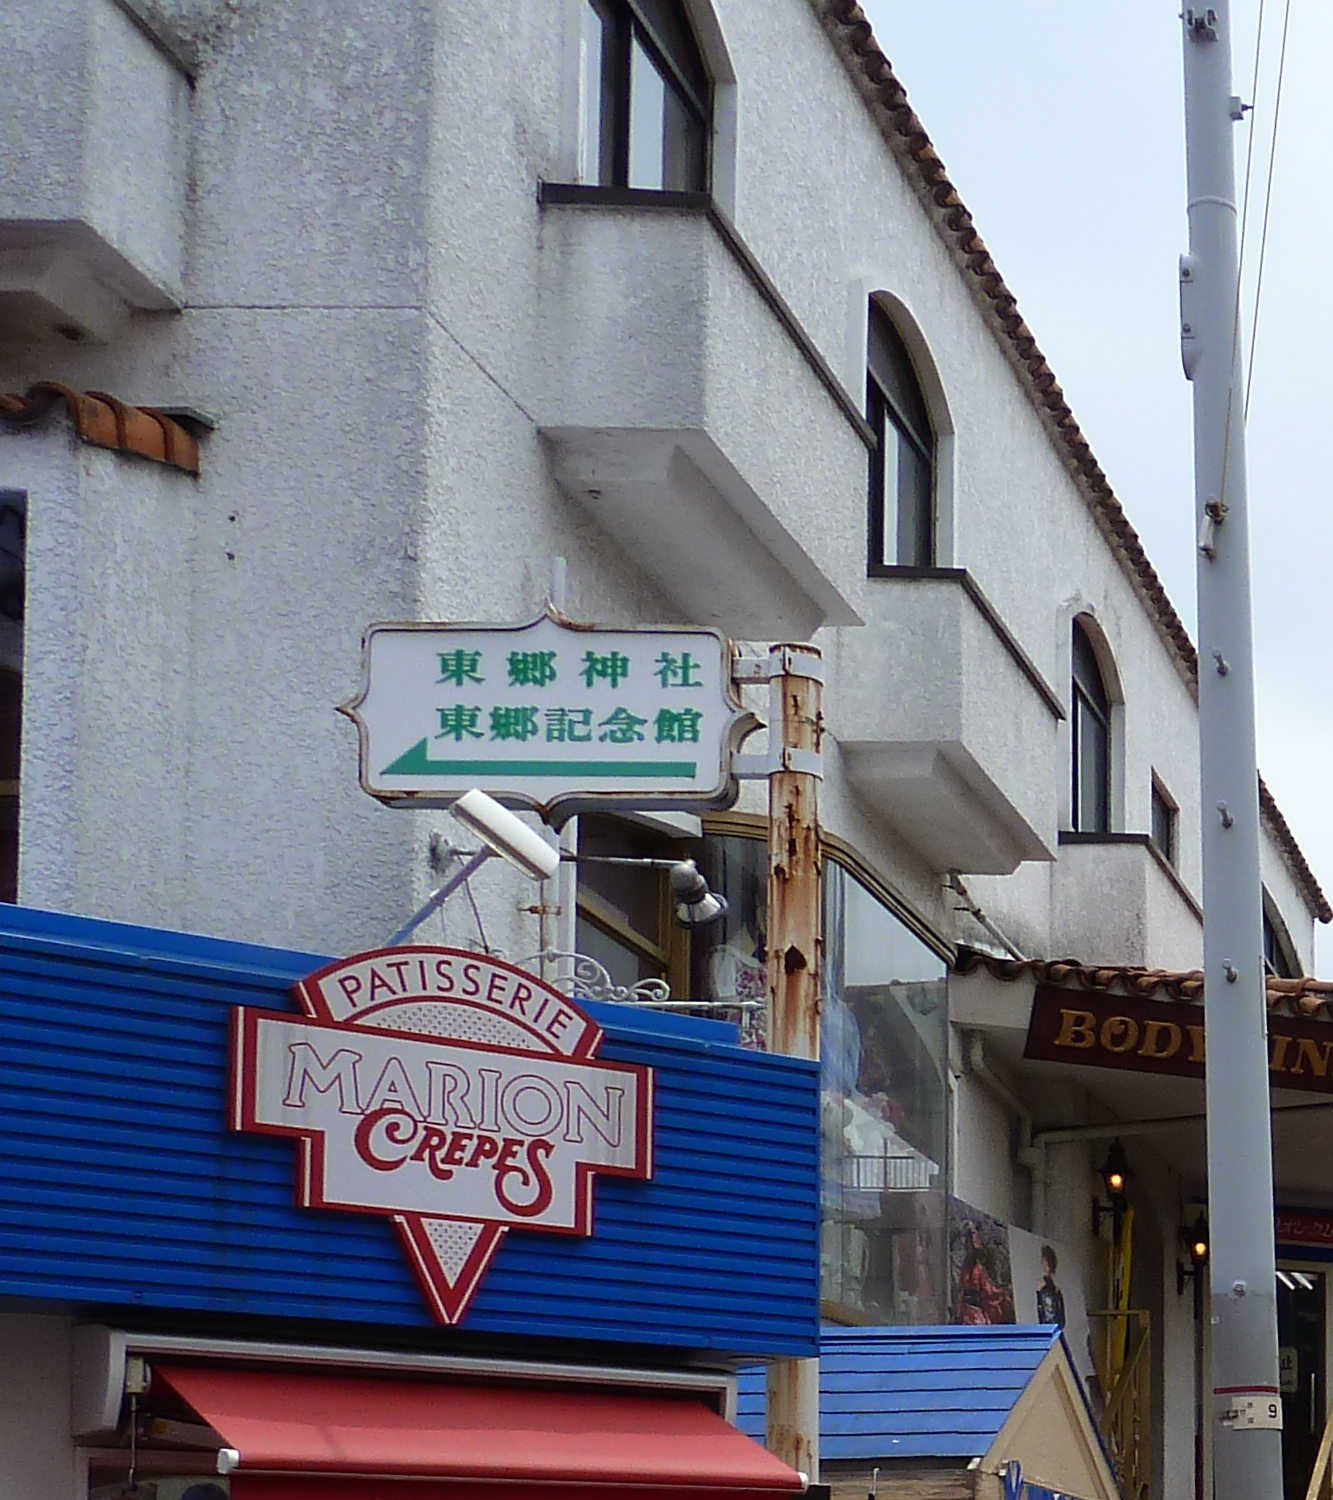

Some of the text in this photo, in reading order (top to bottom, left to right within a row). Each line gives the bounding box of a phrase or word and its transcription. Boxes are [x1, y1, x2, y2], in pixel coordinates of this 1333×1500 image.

[436, 649, 704, 689] 東郷神社
[436, 705, 704, 744] 東郷記念館
[336, 958, 576, 1041] PATISSERIE
[282, 1043, 626, 1147] MARION
[354, 1109, 556, 1217] CREPES
[1268, 1403, 1278, 1418] 9
